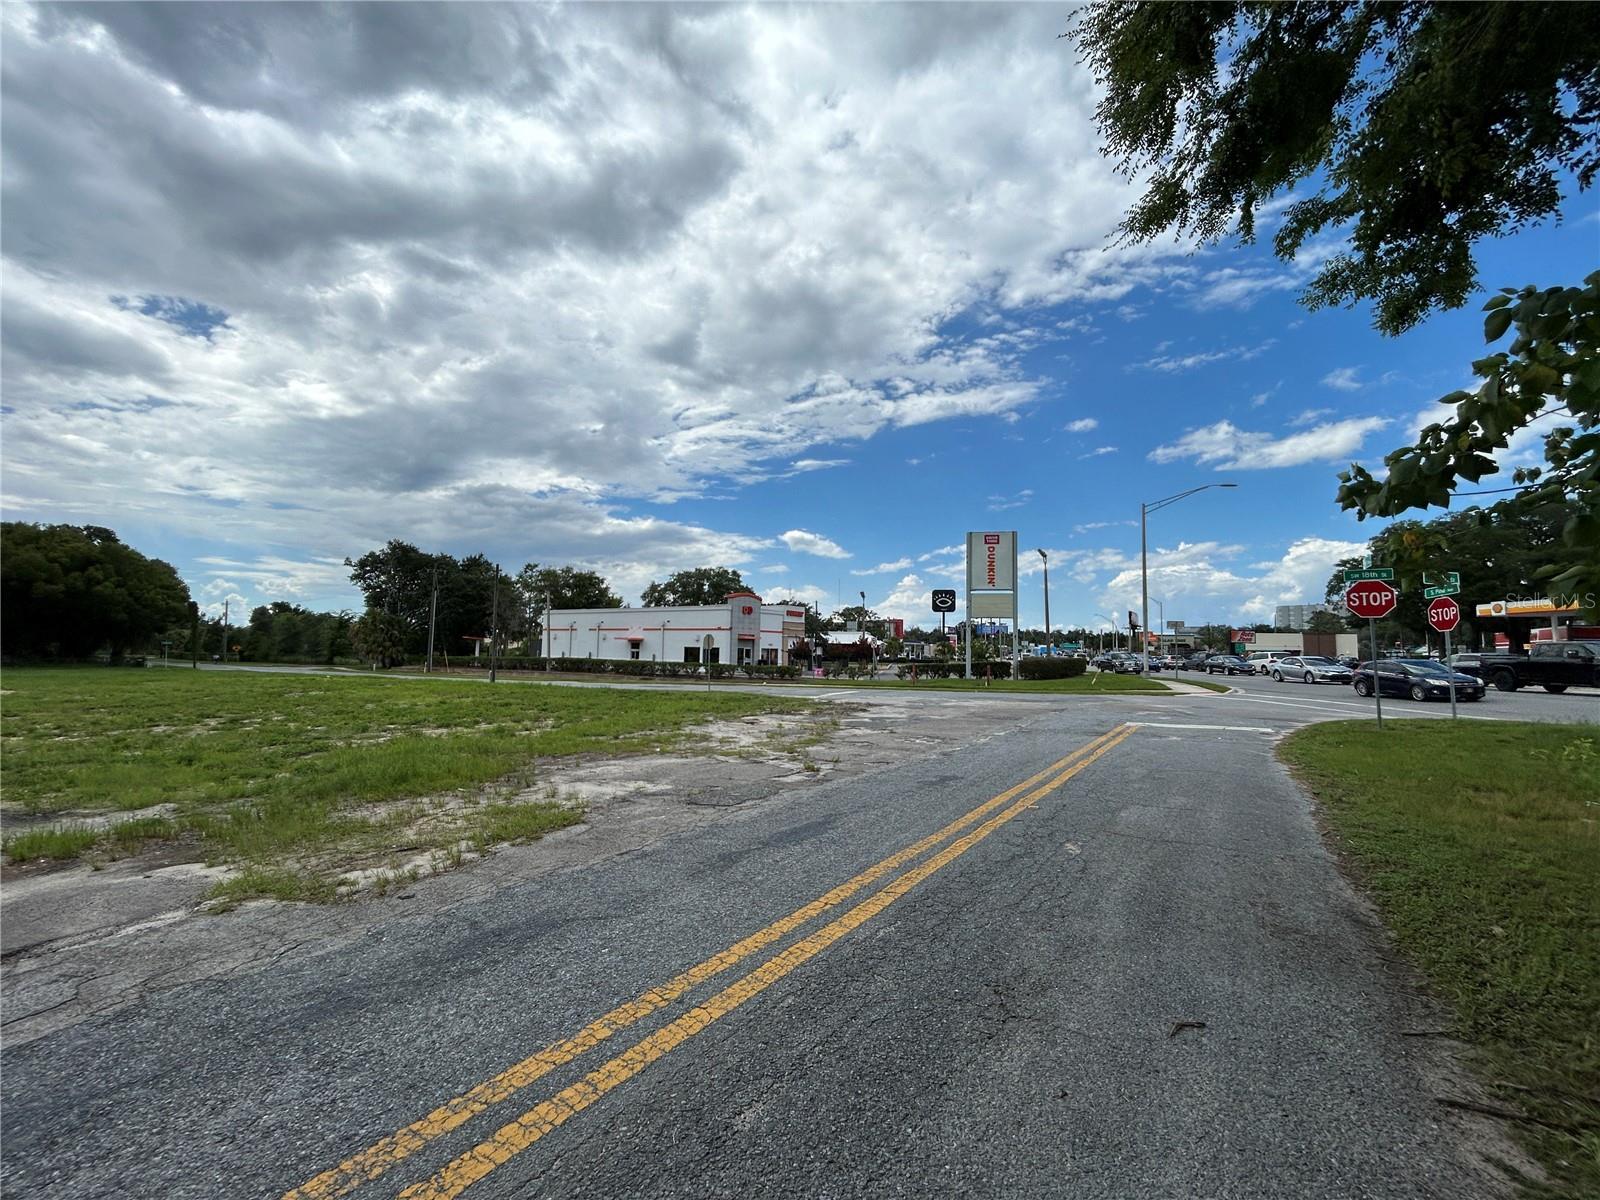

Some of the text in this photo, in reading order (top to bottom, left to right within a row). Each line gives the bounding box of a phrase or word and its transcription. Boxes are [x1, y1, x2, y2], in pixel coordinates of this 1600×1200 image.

[987, 545, 996, 587] DUNKIN'
[1349, 591, 1392, 606] STOP
[1430, 606, 1457, 622] STOP
